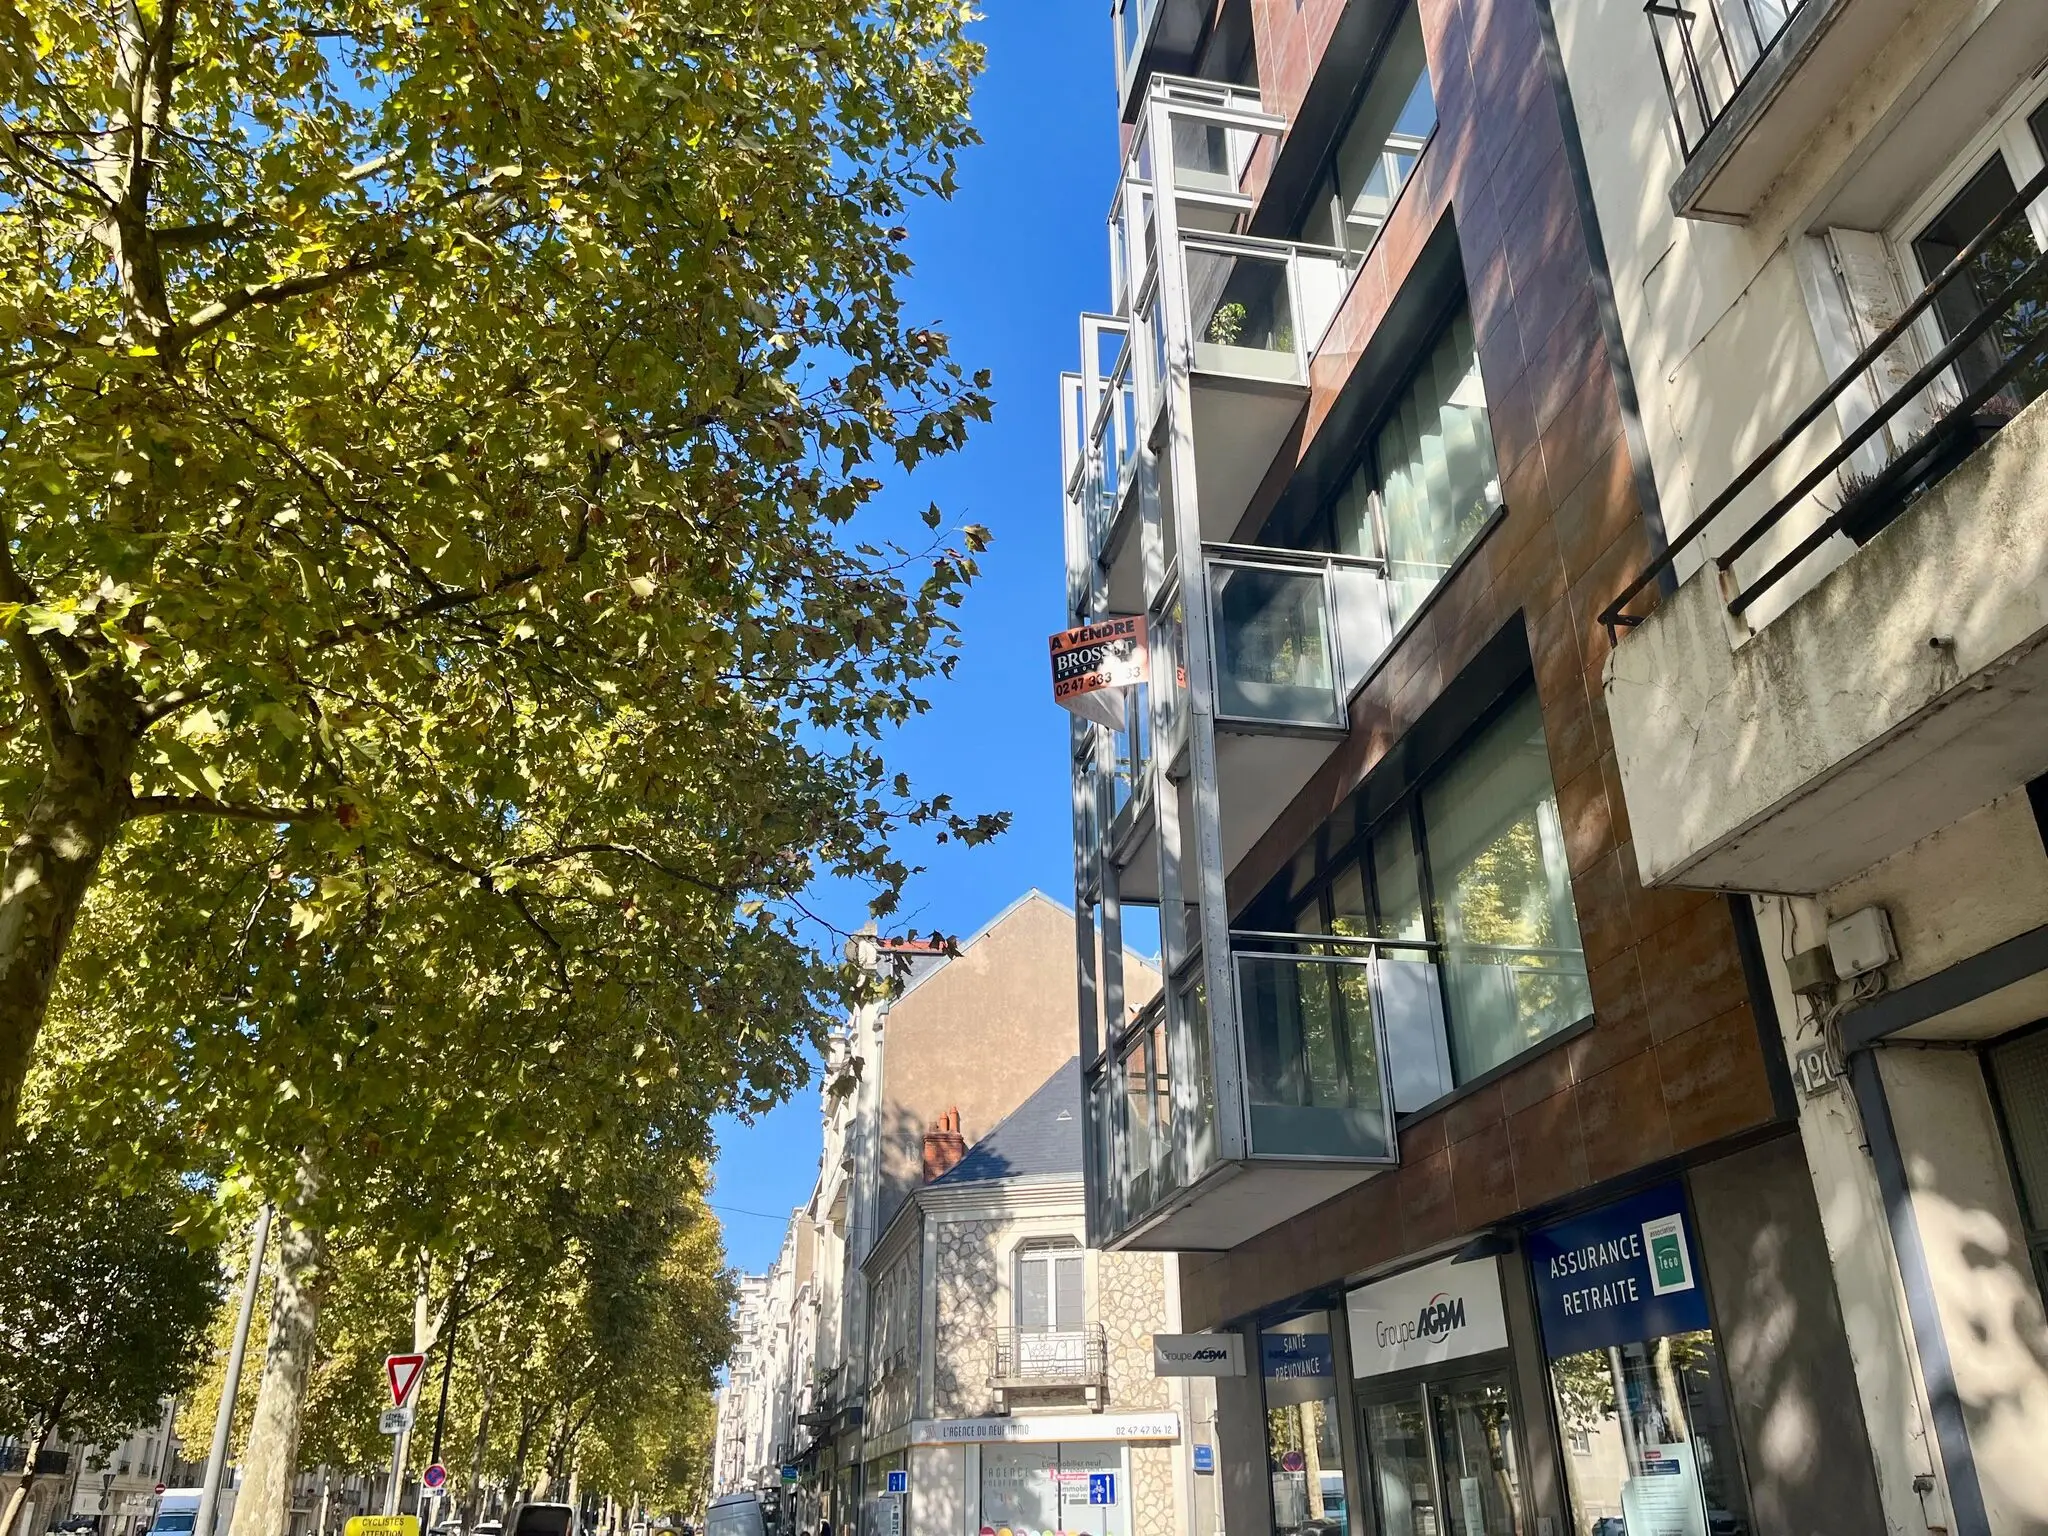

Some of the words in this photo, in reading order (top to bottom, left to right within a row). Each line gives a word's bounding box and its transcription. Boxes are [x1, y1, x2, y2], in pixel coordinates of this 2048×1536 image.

[1051, 637, 1063, 651] A
[1067, 620, 1135, 644] VENDRE
[1057, 640, 1133, 671] BROSST
[1550, 1234, 1641, 1280] ASSURANCE
[1562, 1277, 1640, 1316] RETRAITE
[1376, 1319, 1416, 1351] Groupe
[1416, 1296, 1466, 1340] AGPM
[1275, 1356, 1321, 1383] PRÉVOYANCE
[1116, 1427, 1126, 1435] 02
[1128, 1426, 1138, 1435] 47
[1140, 1426, 1150, 1434] 47
[1152, 1426, 1162, 1434] 04
[1164, 1425, 1172, 1434] 12
[362, 1517, 405, 1527] CYCLISTES
